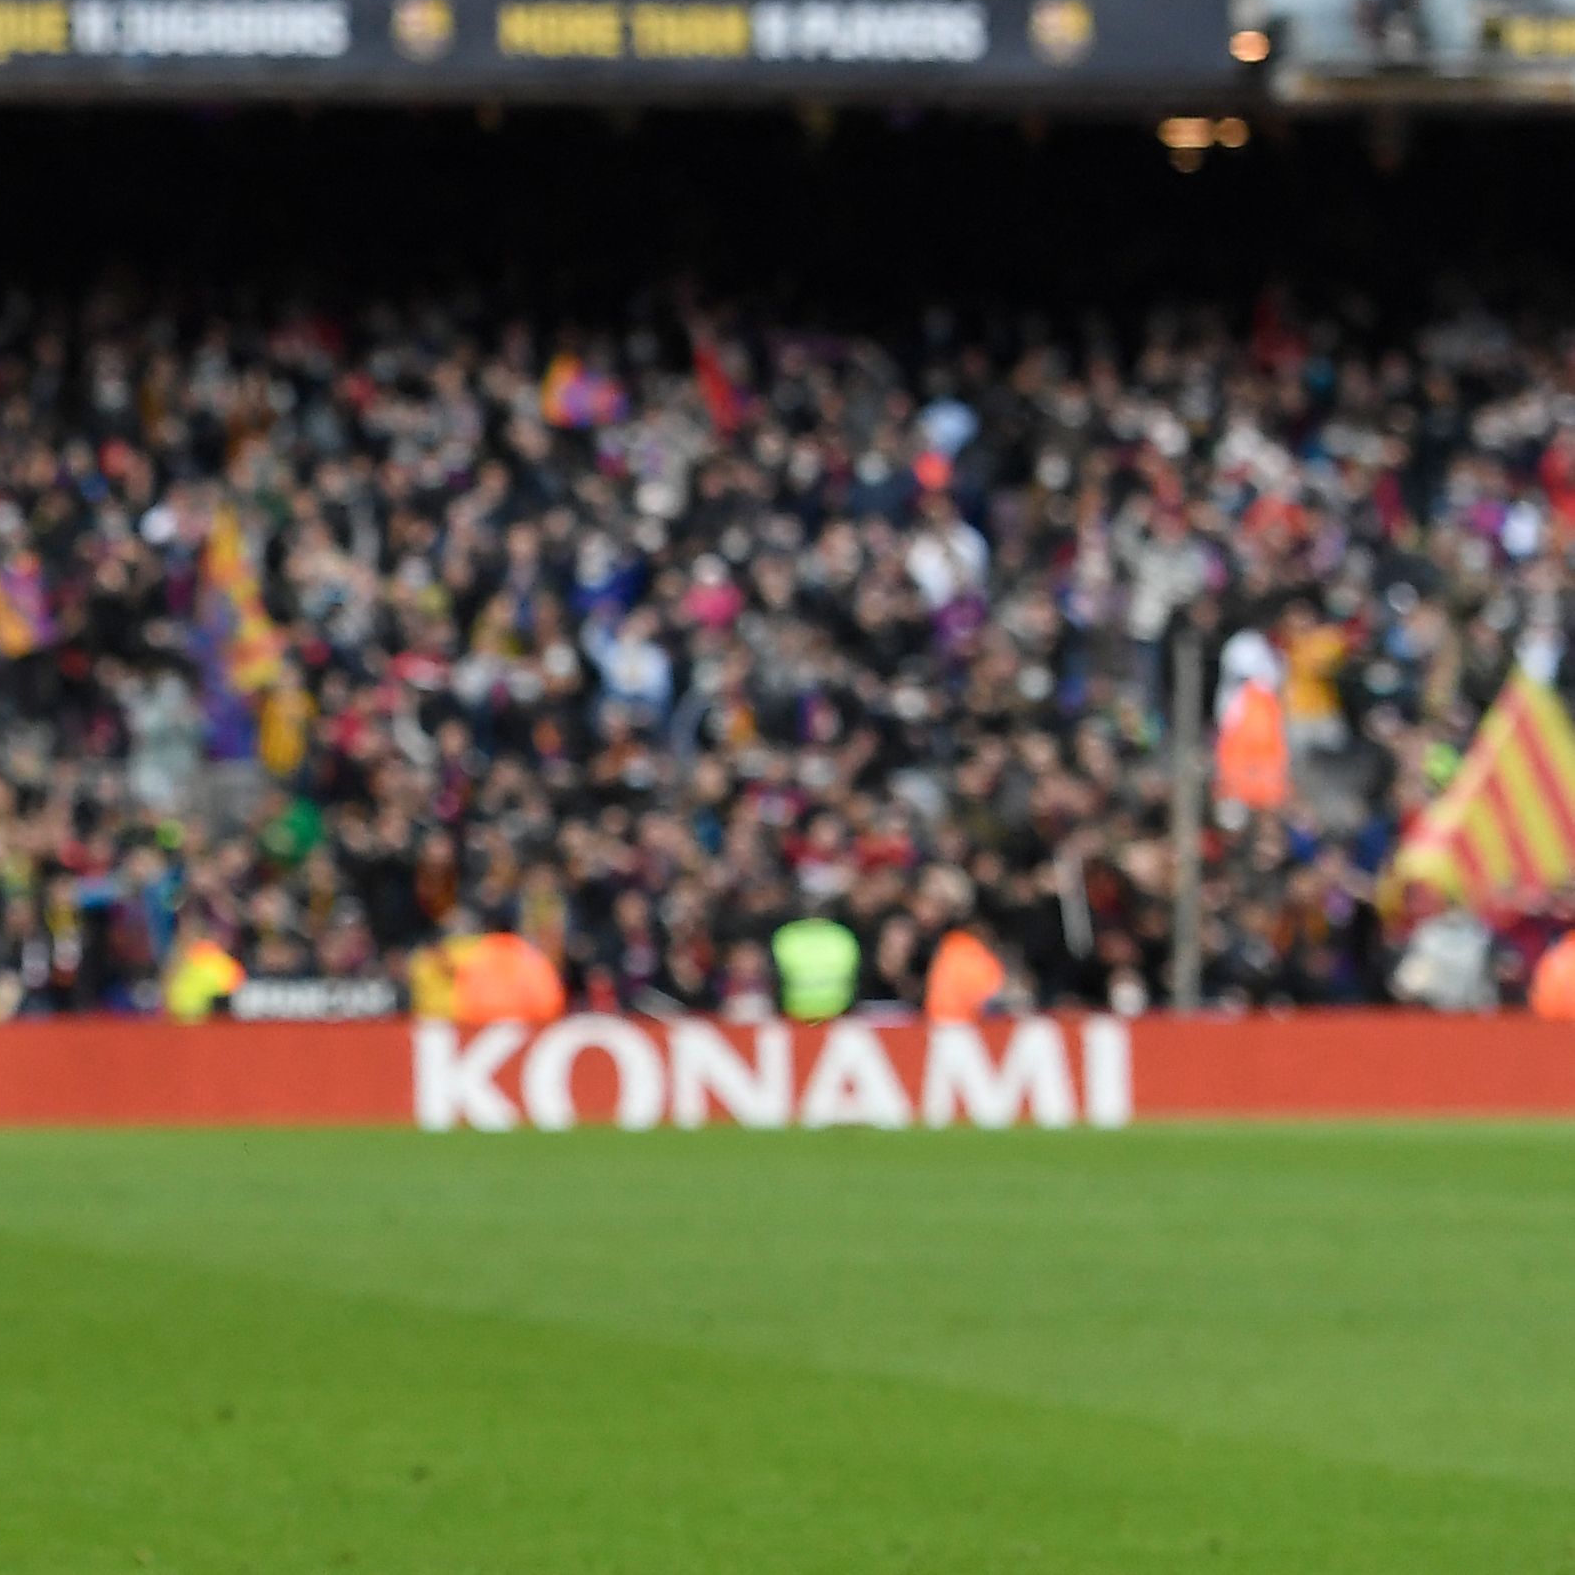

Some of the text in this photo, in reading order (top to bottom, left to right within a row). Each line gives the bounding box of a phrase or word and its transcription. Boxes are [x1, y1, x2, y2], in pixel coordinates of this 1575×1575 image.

[497, 1, 623, 57] MORE
[632, 1, 748, 58] THAN
[794, 0, 987, 61] PLAYERS
[411, 1014, 1135, 1132] KONAMI
